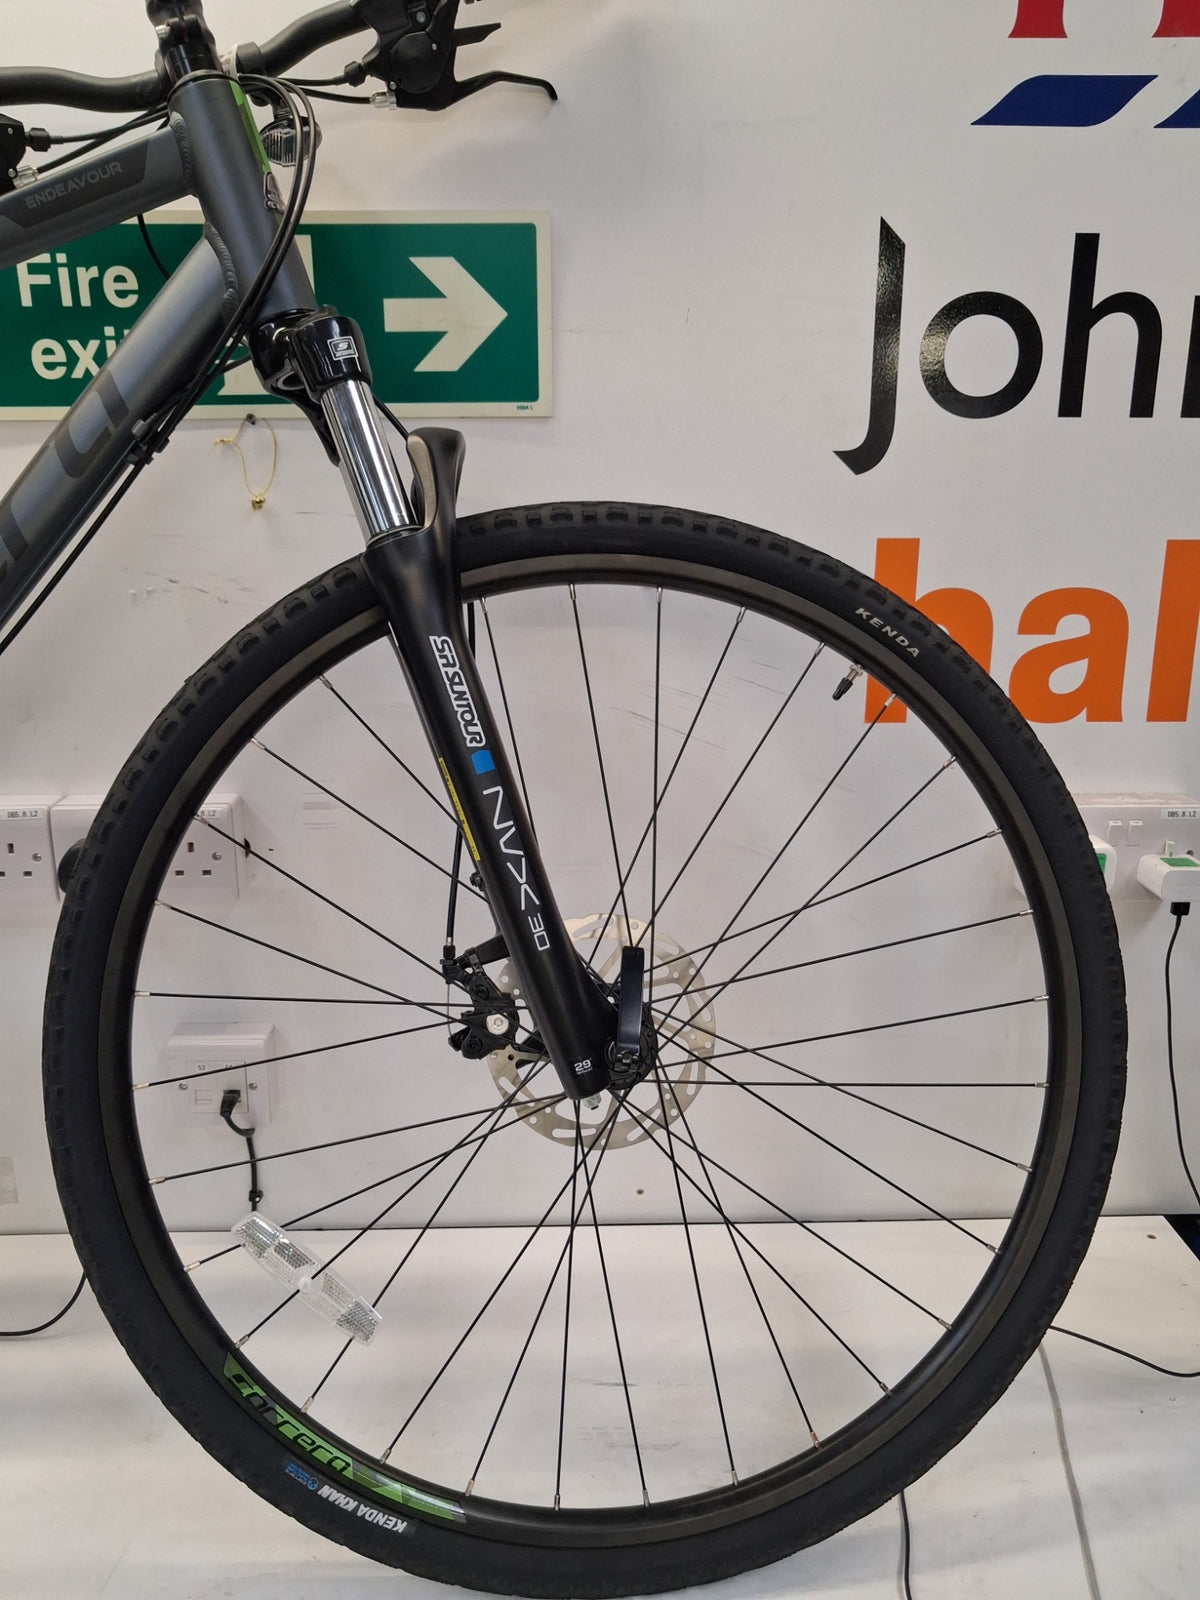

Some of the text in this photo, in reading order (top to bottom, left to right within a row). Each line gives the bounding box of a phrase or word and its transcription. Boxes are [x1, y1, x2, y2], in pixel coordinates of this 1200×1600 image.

[25, 161, 123, 209] ENDEAVOUR
[16, 253, 139, 308] Fire
[31, 326, 130, 380] exi
[832, 216, 1200, 475] Joh
[855, 608, 920, 658] KENDA
[444, 669, 486, 747] SUNTOUR
[482, 786, 551, 952] NVX 30
[229, 1373, 351, 1475] carrera
[317, 1484, 408, 1533] KENDA KHAN
